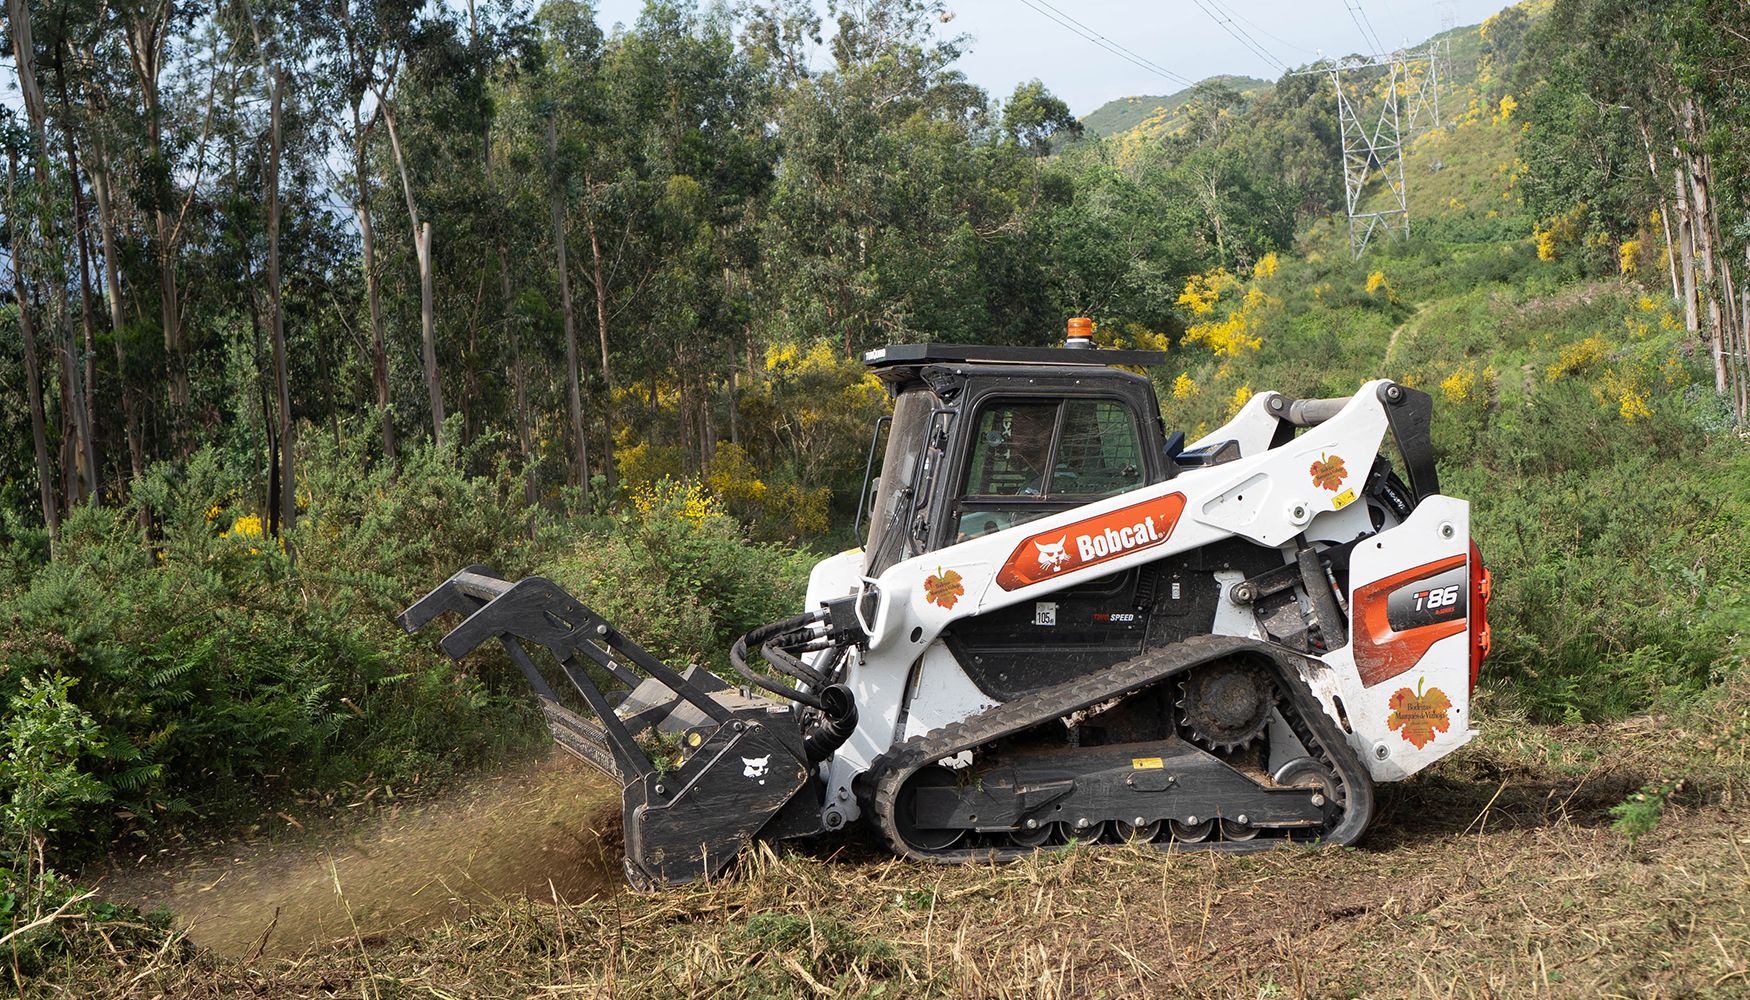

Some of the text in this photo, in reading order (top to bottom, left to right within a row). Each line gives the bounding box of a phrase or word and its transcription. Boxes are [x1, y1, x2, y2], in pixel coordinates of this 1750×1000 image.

[1076, 516, 1158, 562] Bobcat
[1413, 585, 1459, 611] T86
[1038, 612, 1050, 624] 105
[1093, 613, 1134, 621] TWO SPEED
[1407, 702, 1431, 711] Bodegas
